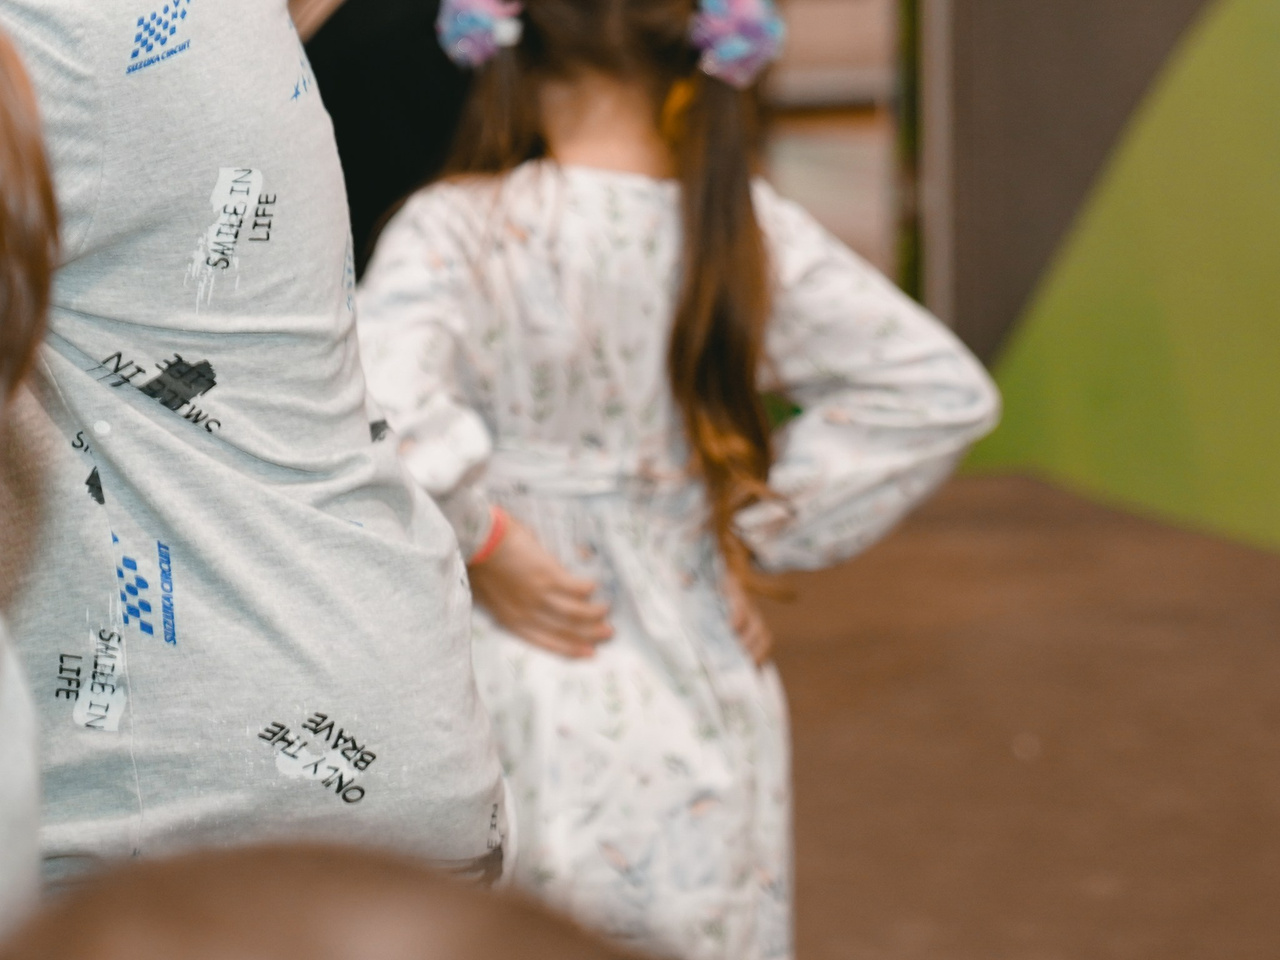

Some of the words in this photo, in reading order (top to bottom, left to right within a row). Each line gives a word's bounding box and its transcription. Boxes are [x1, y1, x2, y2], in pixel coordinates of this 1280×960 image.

[125, 54, 160, 75] SUZUKA
[161, 38, 191, 60] CIRCUIT
[206, 204, 248, 270] SMILE
[229, 168, 253, 196] IN
[248, 193, 277, 242] LIFE
[157, 539, 173, 593] CIRCUIT
[161, 593, 177, 647] SUZUKA
[55, 653, 83, 701] LIFE
[90, 628, 121, 696] SMILE
[84, 700, 110, 729] IN
[257, 721, 308, 760] THE
[301, 711, 377, 772] BRAVE
[302, 756, 366, 804] ONLY
